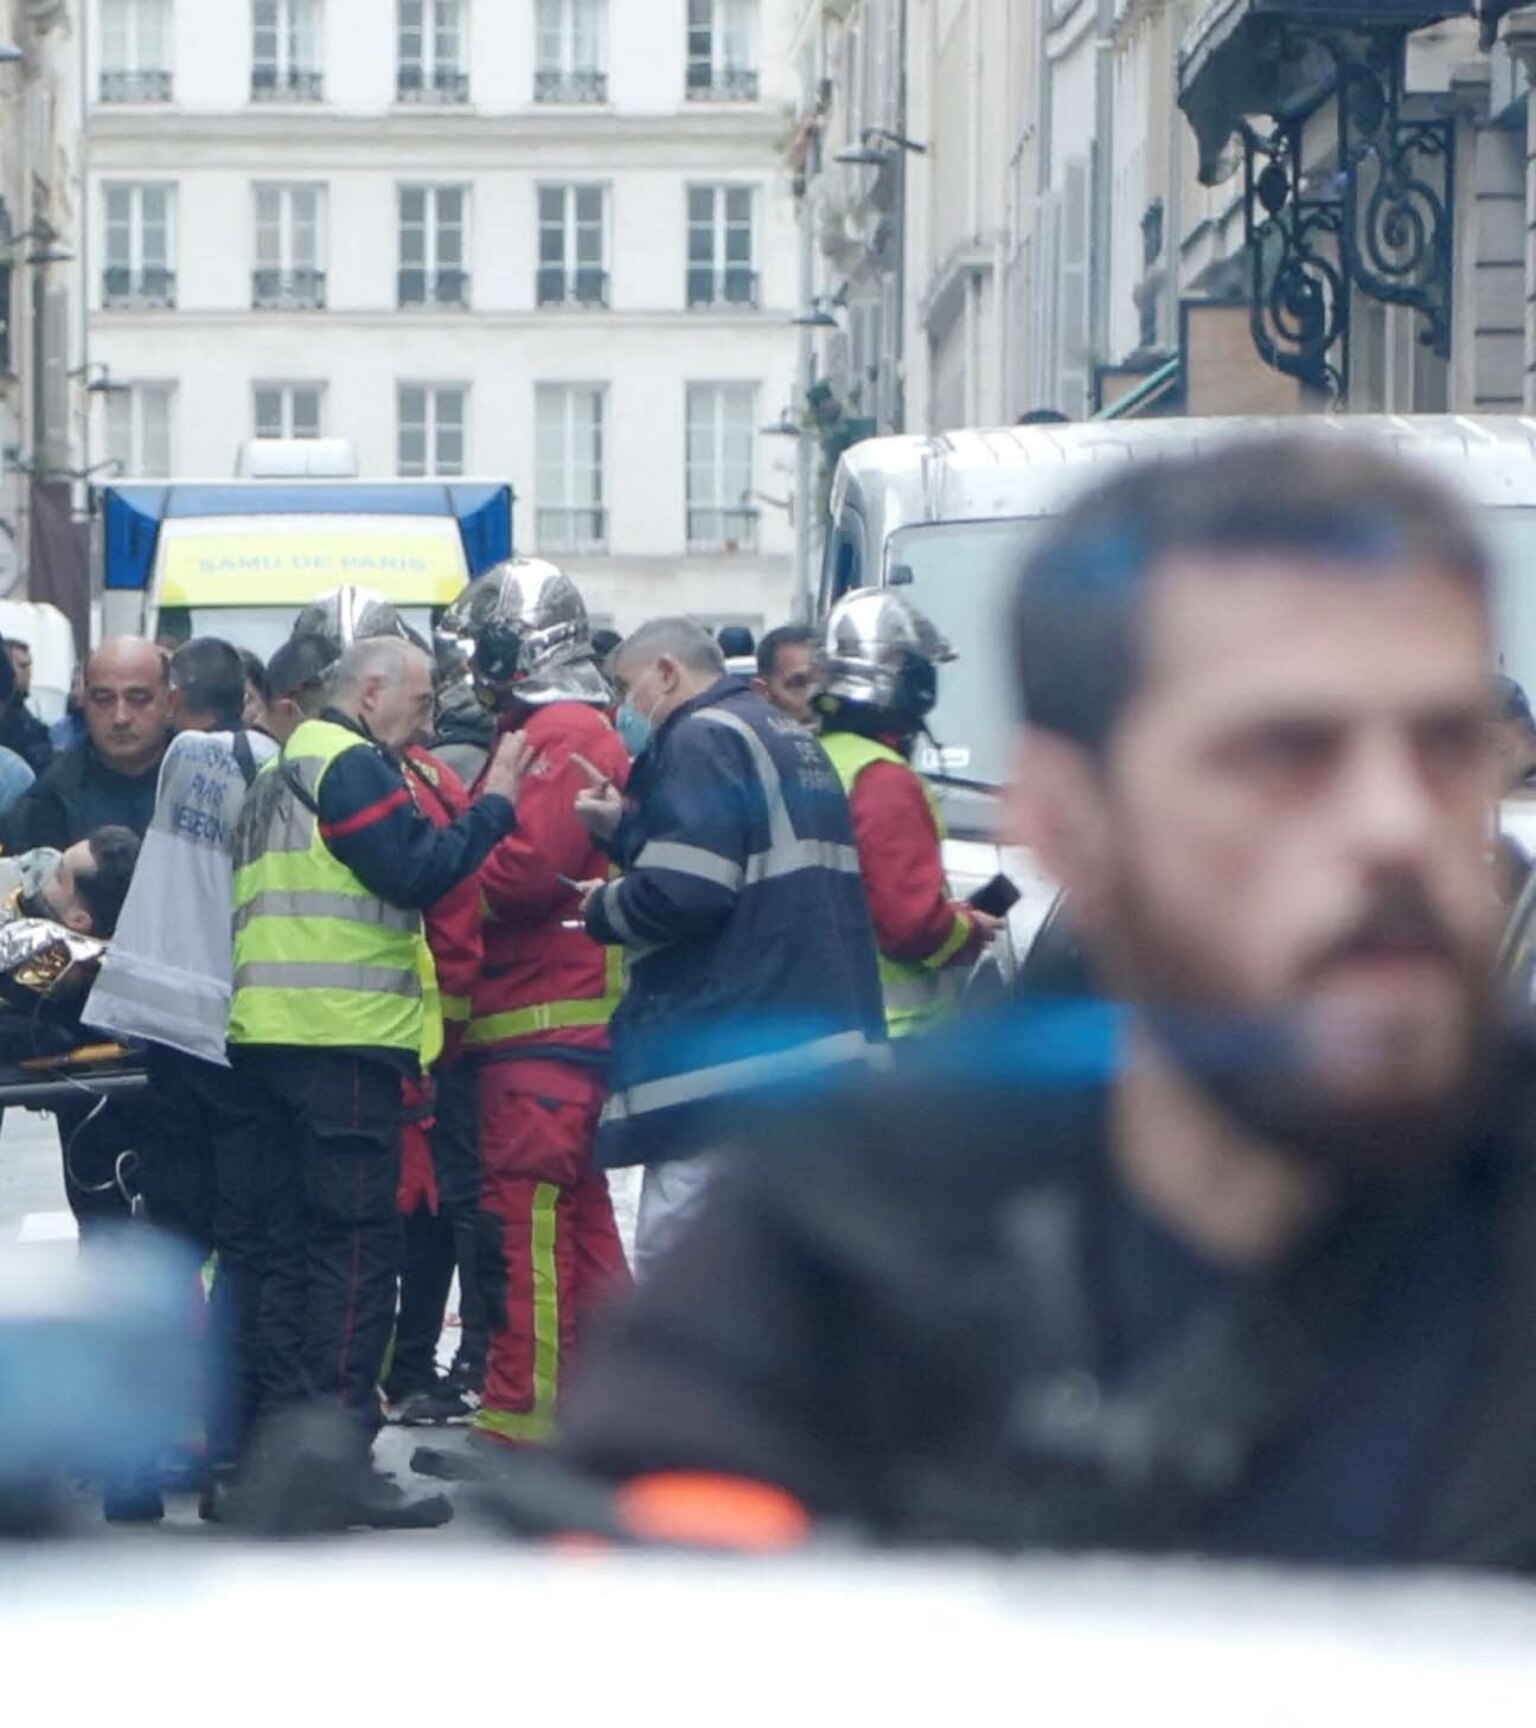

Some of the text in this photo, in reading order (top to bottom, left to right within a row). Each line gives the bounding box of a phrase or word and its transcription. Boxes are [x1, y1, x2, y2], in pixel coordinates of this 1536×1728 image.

[199, 555, 426, 573] SAMU DE PARIS
